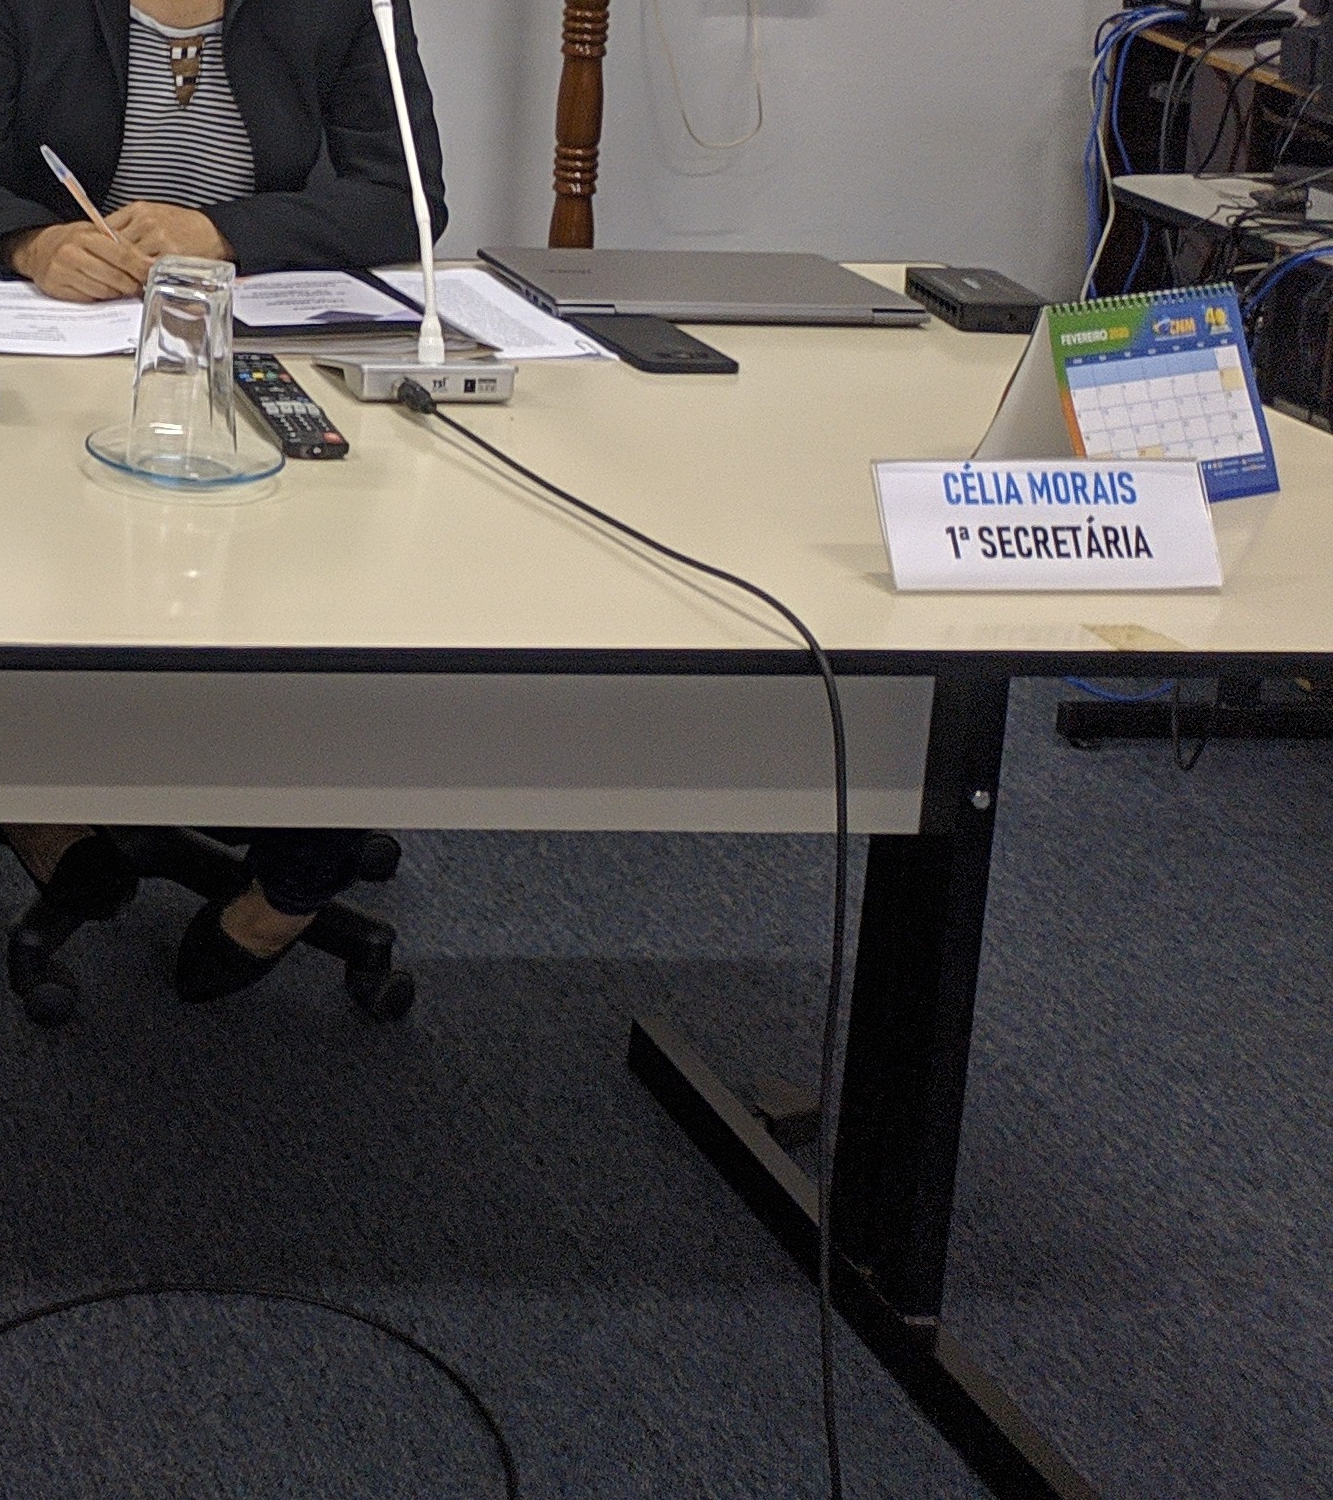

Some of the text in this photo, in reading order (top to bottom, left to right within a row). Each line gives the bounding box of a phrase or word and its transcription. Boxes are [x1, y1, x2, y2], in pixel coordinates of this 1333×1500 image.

[943, 463, 1138, 506] CÉLIA MORAIS
[945, 516, 1154, 560] 1ª SECRETÁRIA
